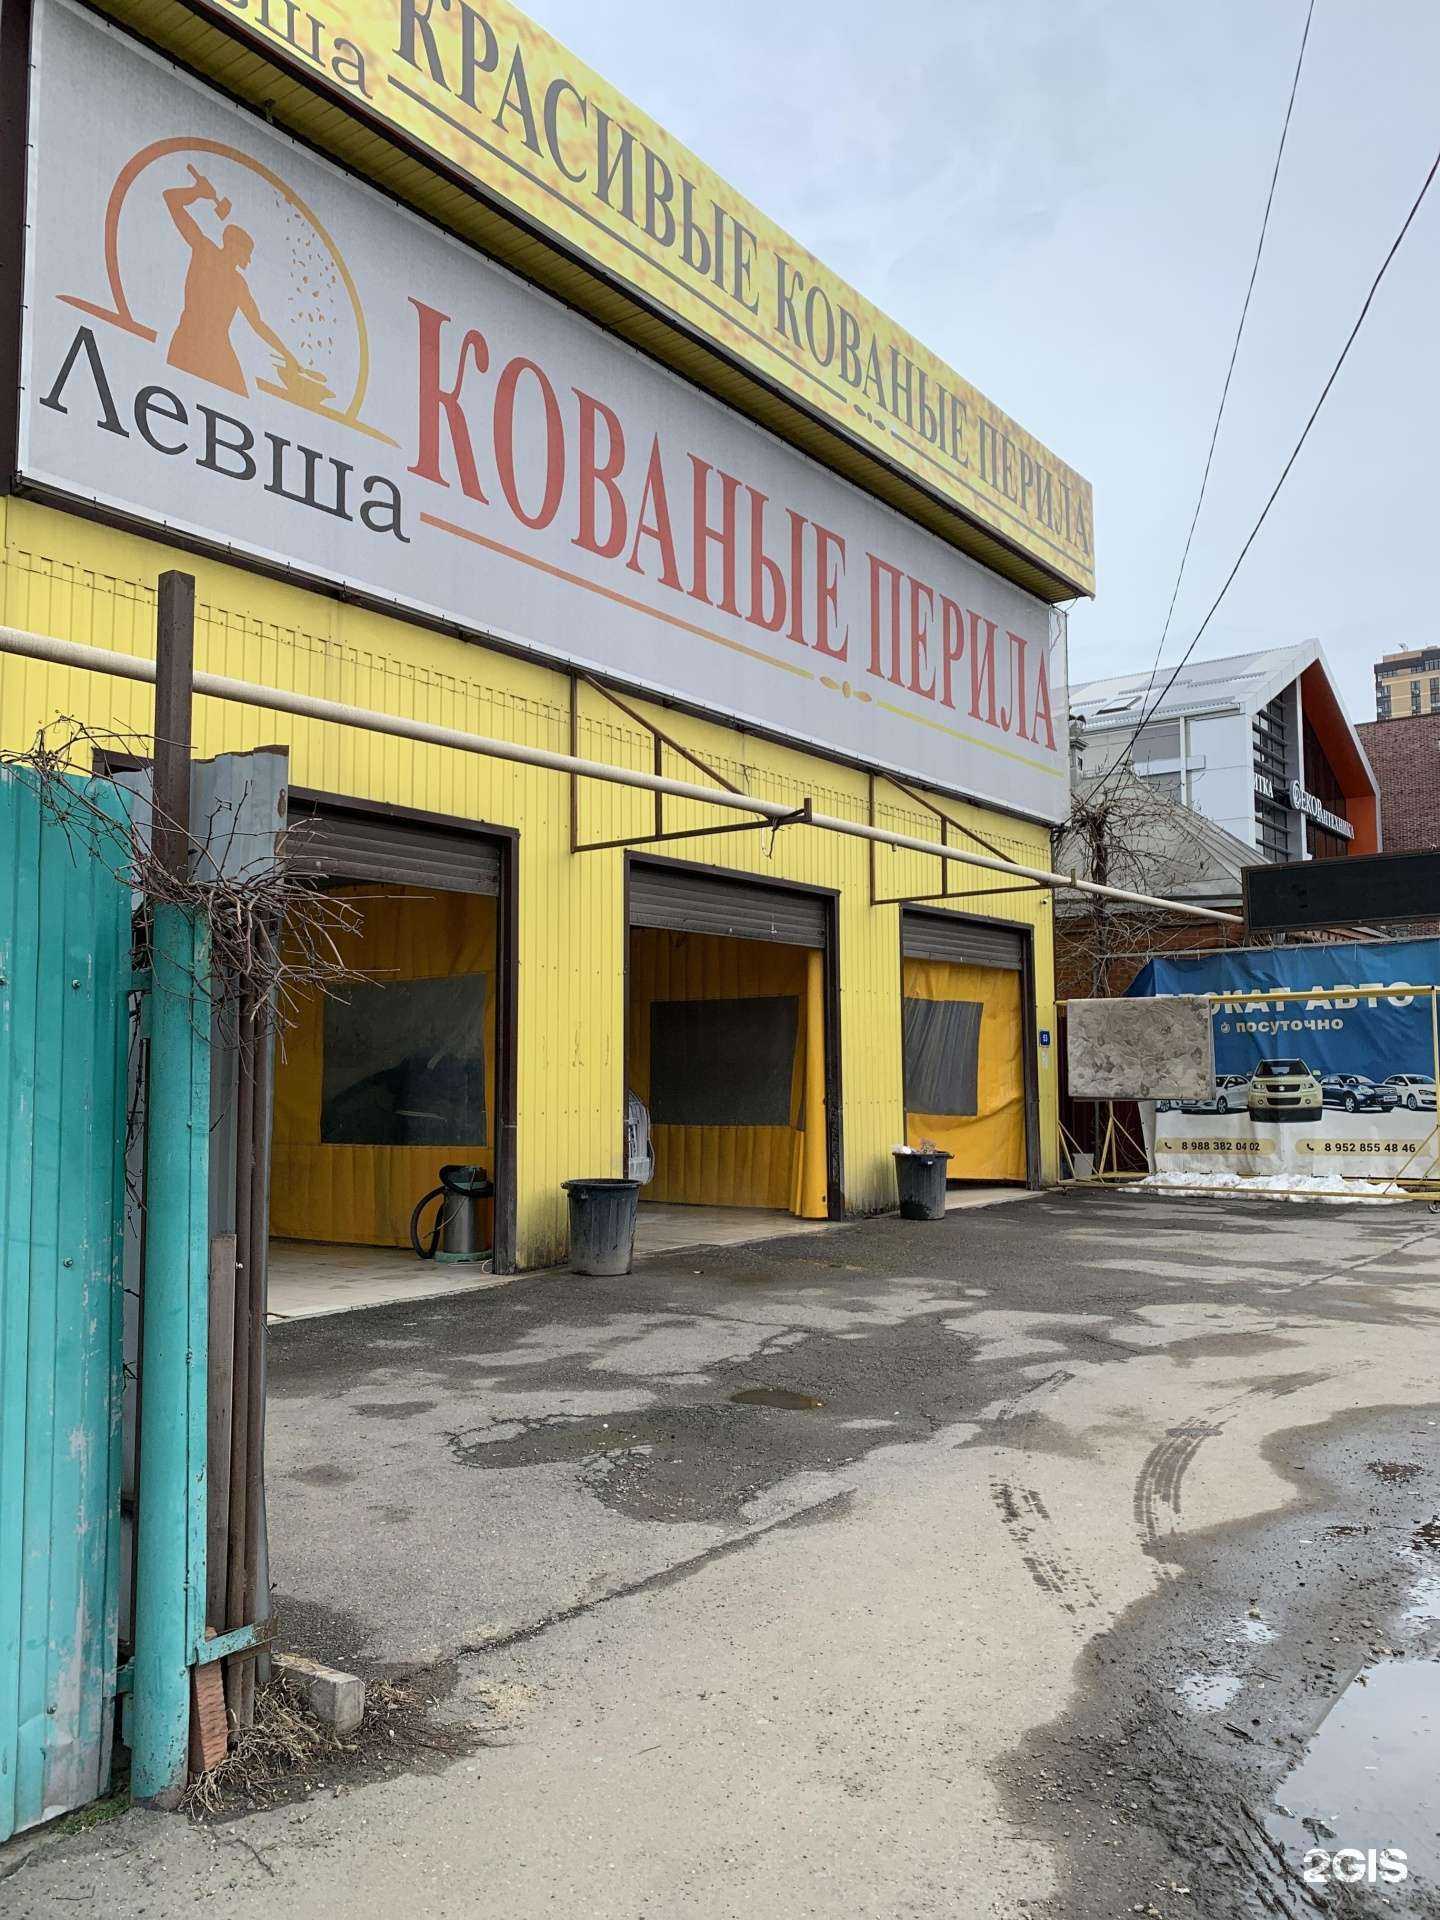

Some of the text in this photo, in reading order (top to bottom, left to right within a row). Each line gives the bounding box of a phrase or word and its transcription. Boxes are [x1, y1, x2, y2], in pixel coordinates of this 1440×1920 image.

[392, 0, 1089, 555] КРАСИВЫЕ КОВАНЫЕ ПЕРИЛА
[39, 325, 411, 543] Левша
[406, 296, 1057, 752] КОВАНЫЕ ПЕРИЛА
[1236, 1018, 1344, 1035] посуточно
[1181, 1141, 1260, 1151] 8 988 382 04 02
[1324, 1143, 1416, 1153] 8 952 855 48 46
